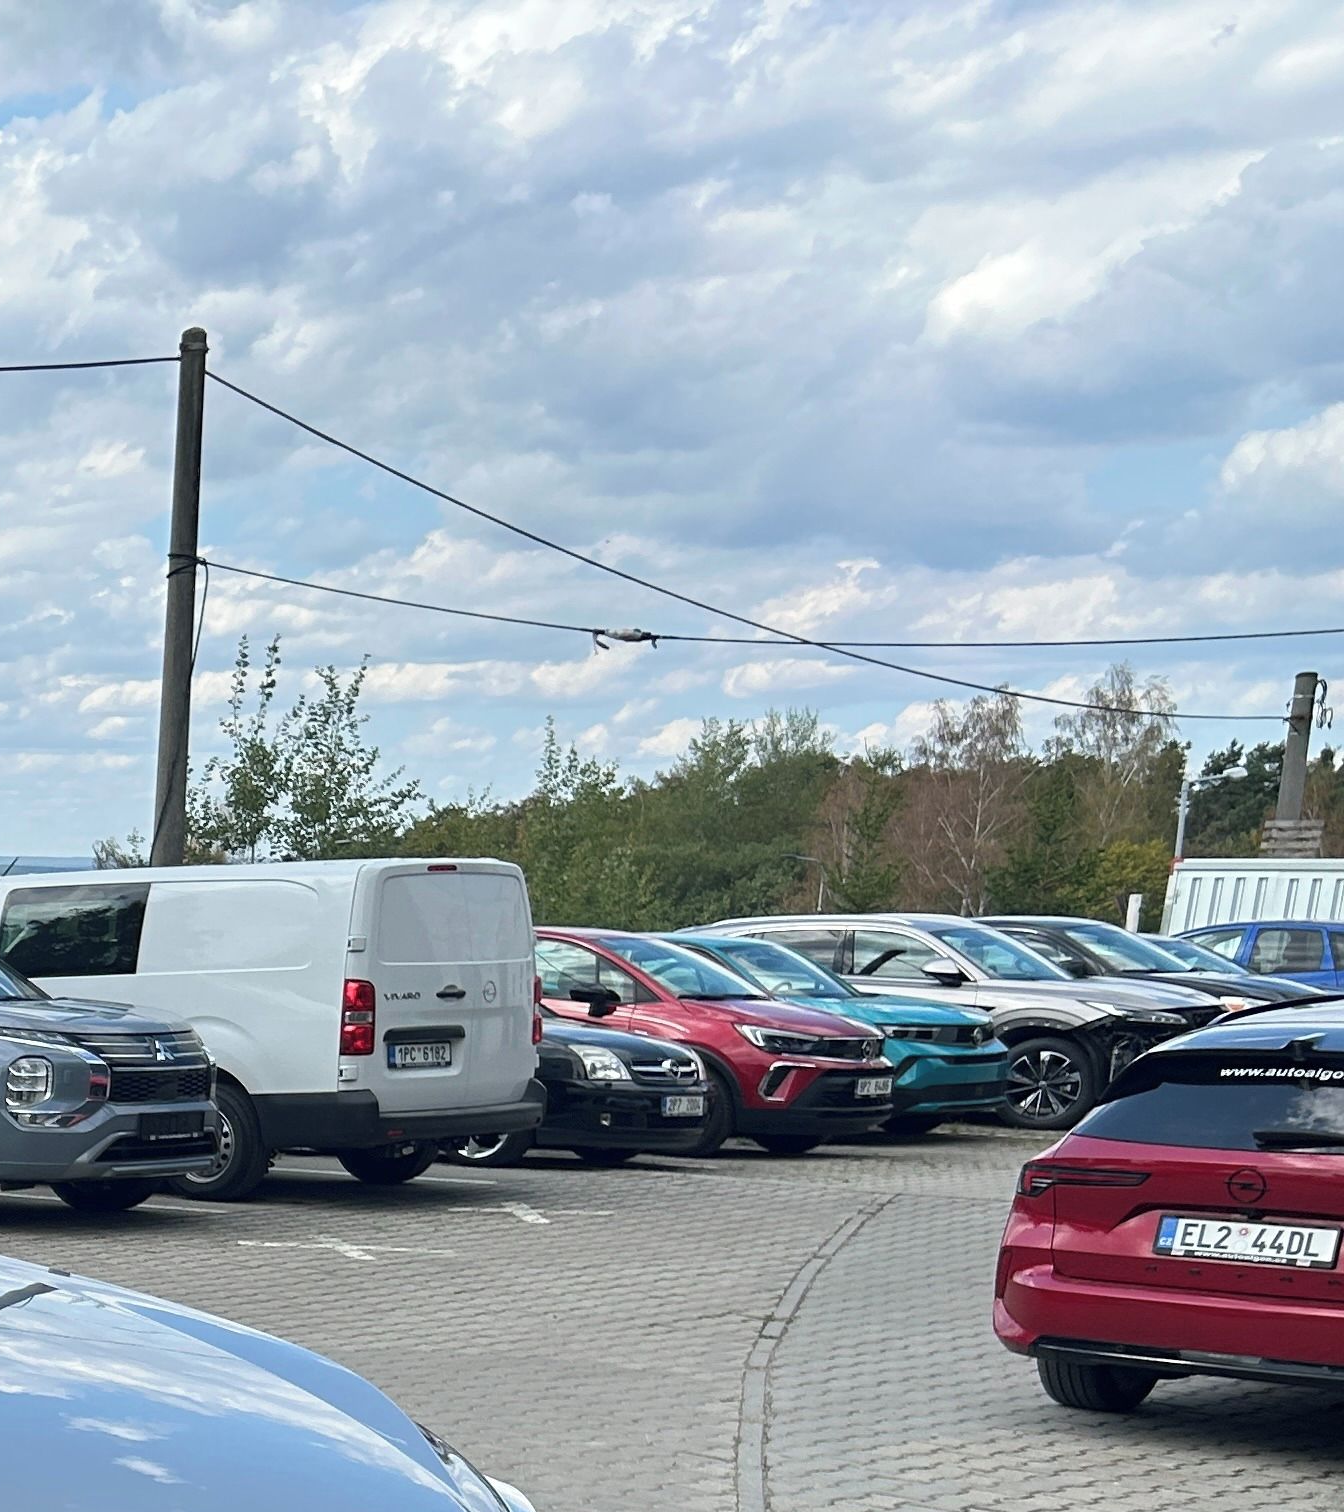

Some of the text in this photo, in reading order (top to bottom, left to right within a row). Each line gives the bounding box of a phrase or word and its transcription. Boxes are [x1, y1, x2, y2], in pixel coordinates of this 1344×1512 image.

[383, 991, 421, 1001] VIVARO
[398, 1046, 416, 1063] 1PC
[1220, 1067, 1344, 1081] www.autoalgo
[1159, 1237, 1173, 1246] CZ
[1180, 1222, 1320, 1258] EL2 44DL
